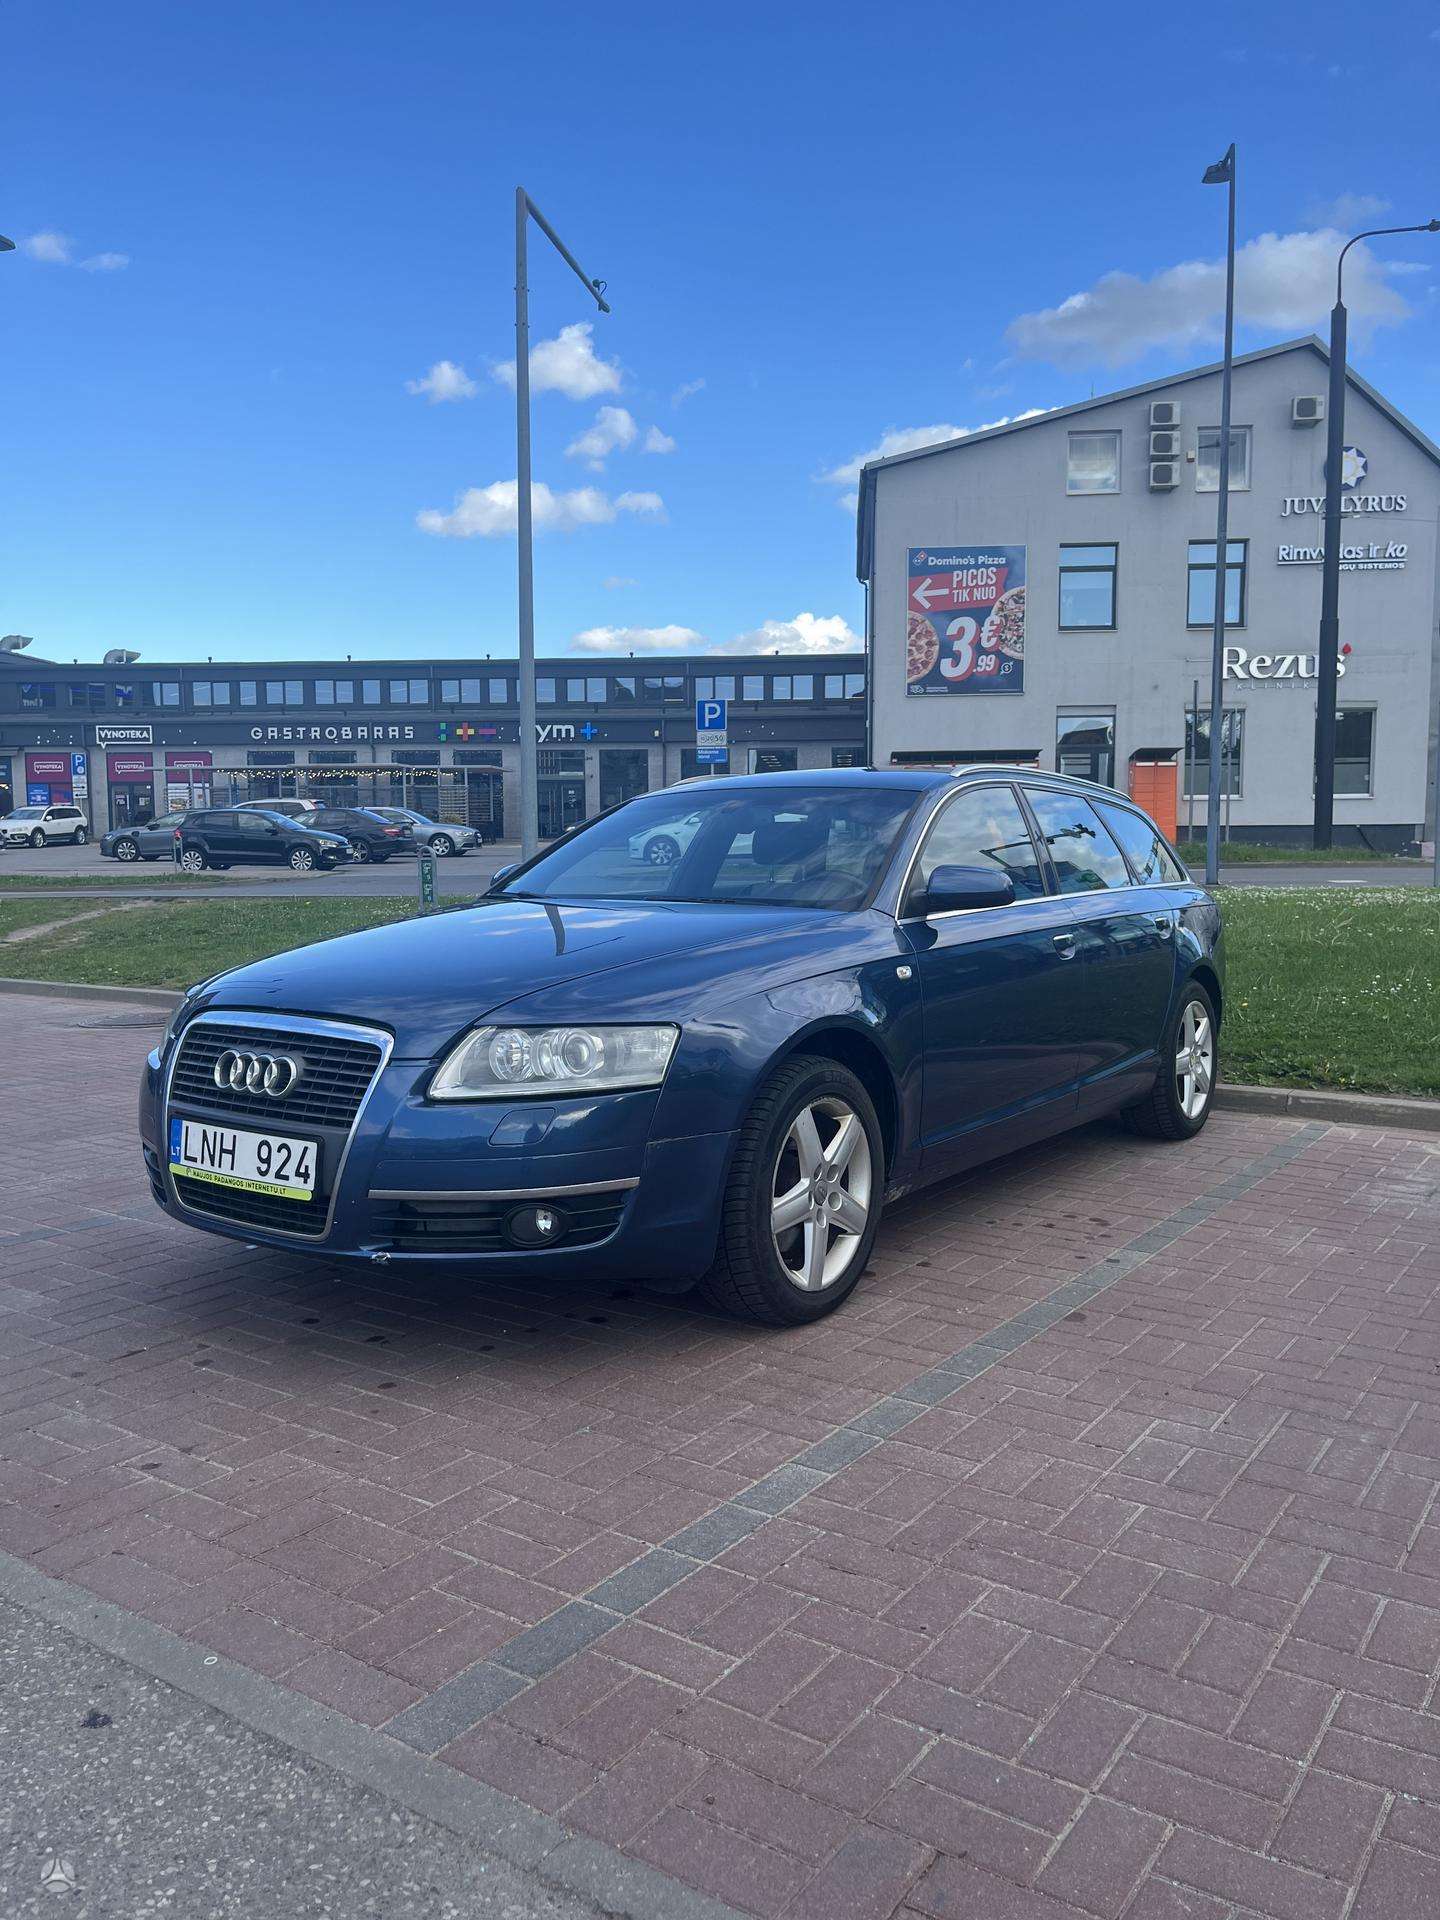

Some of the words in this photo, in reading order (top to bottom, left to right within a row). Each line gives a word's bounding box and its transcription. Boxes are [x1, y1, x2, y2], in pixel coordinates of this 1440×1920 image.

[1281, 495, 1407, 517] JUVLYRUS
[1278, 543, 1364, 562] Rimvas
[1369, 542, 1380, 558] ir
[1385, 540, 1408, 558] ko
[928, 555, 975, 566] Domino's
[978, 554, 1006, 565] Pizza
[1357, 562, 1405, 571] SISTEMOS
[952, 566, 997, 588] PICOS
[952, 588, 970, 603] TIK
[973, 586, 996, 601] NUO
[940, 616, 977, 678] 3
[980, 614, 998, 648] €
[1222, 646, 1346, 679] Rezus
[1236, 681, 1311, 691] KLINIK
[705, 703, 721, 727] P
[100, 730, 149, 739] VYNOTEKA
[251, 727, 414, 739] GASTROBARAS
[75, 755, 83, 766] P
[171, 1146, 181, 1156] LT
[183, 1126, 237, 1171] LNH
[256, 1139, 311, 1184] 924
